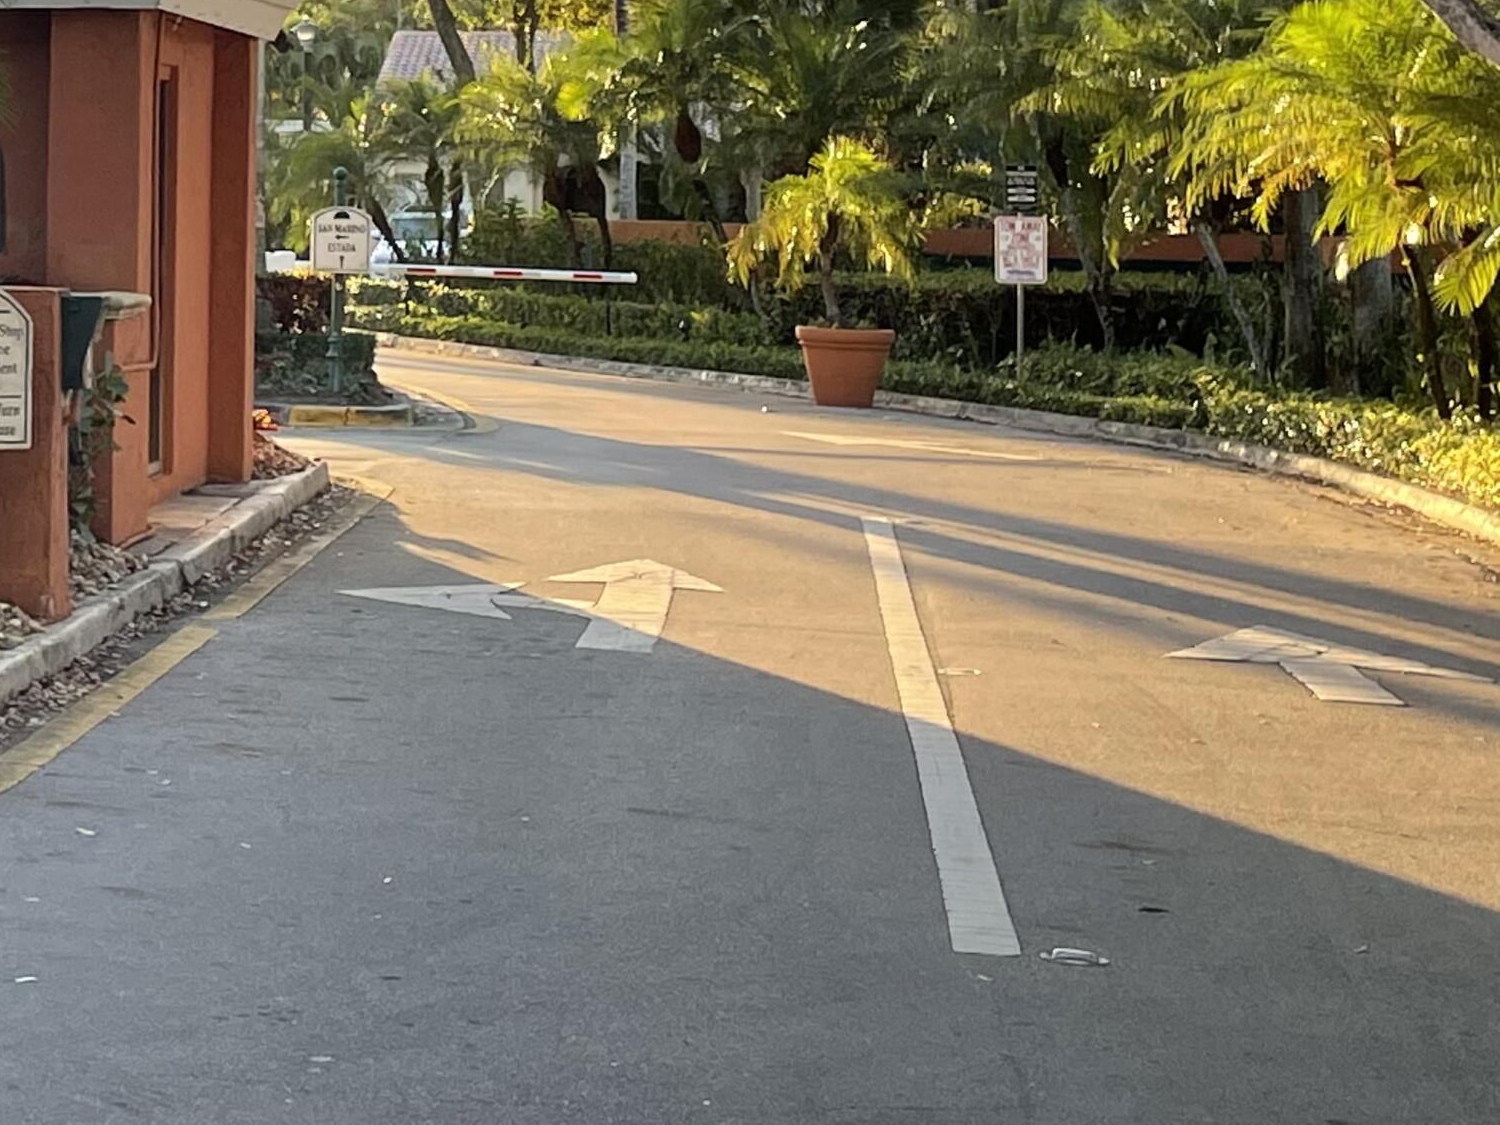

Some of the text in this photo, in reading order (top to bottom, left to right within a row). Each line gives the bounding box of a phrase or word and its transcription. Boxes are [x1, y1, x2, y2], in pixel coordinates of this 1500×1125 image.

[318, 224, 366, 233] SAN MARINO
[328, 243, 356, 252] ESTADA
[0, 324, 23, 340] Stop
